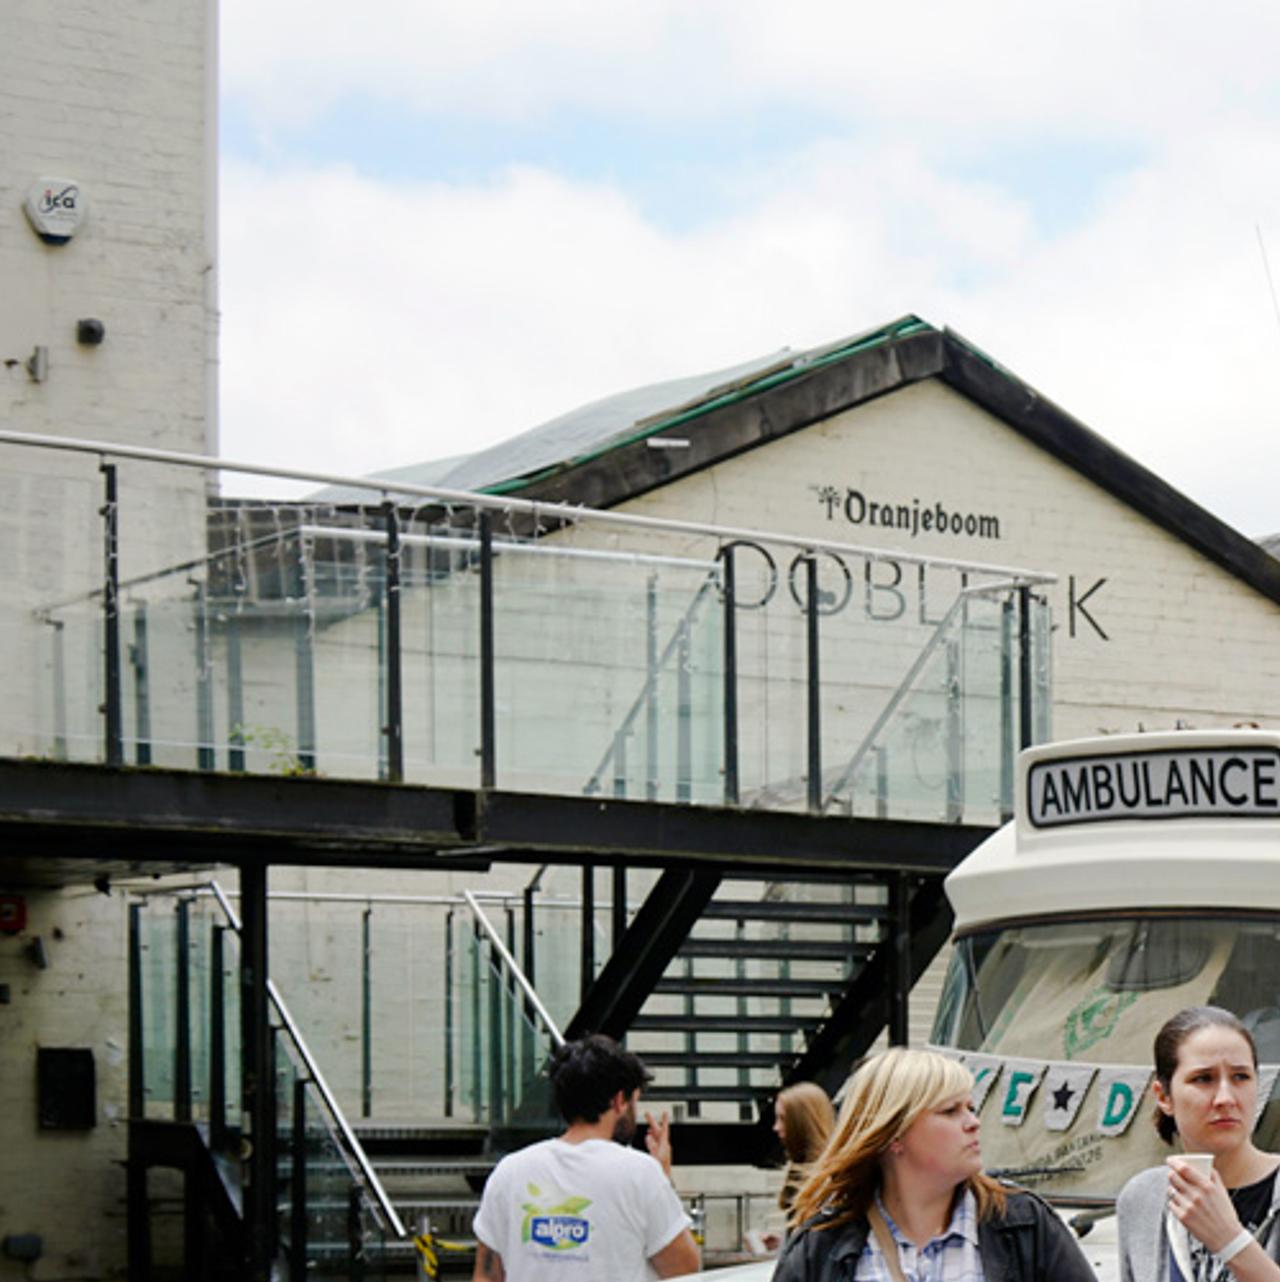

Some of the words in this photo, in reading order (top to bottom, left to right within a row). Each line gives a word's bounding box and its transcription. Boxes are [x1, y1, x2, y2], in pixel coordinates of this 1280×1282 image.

[844, 488, 1001, 540] Oranjeboom
[1040, 756, 1279, 818] AMBULANCE
[535, 1218, 585, 1244] alpro
